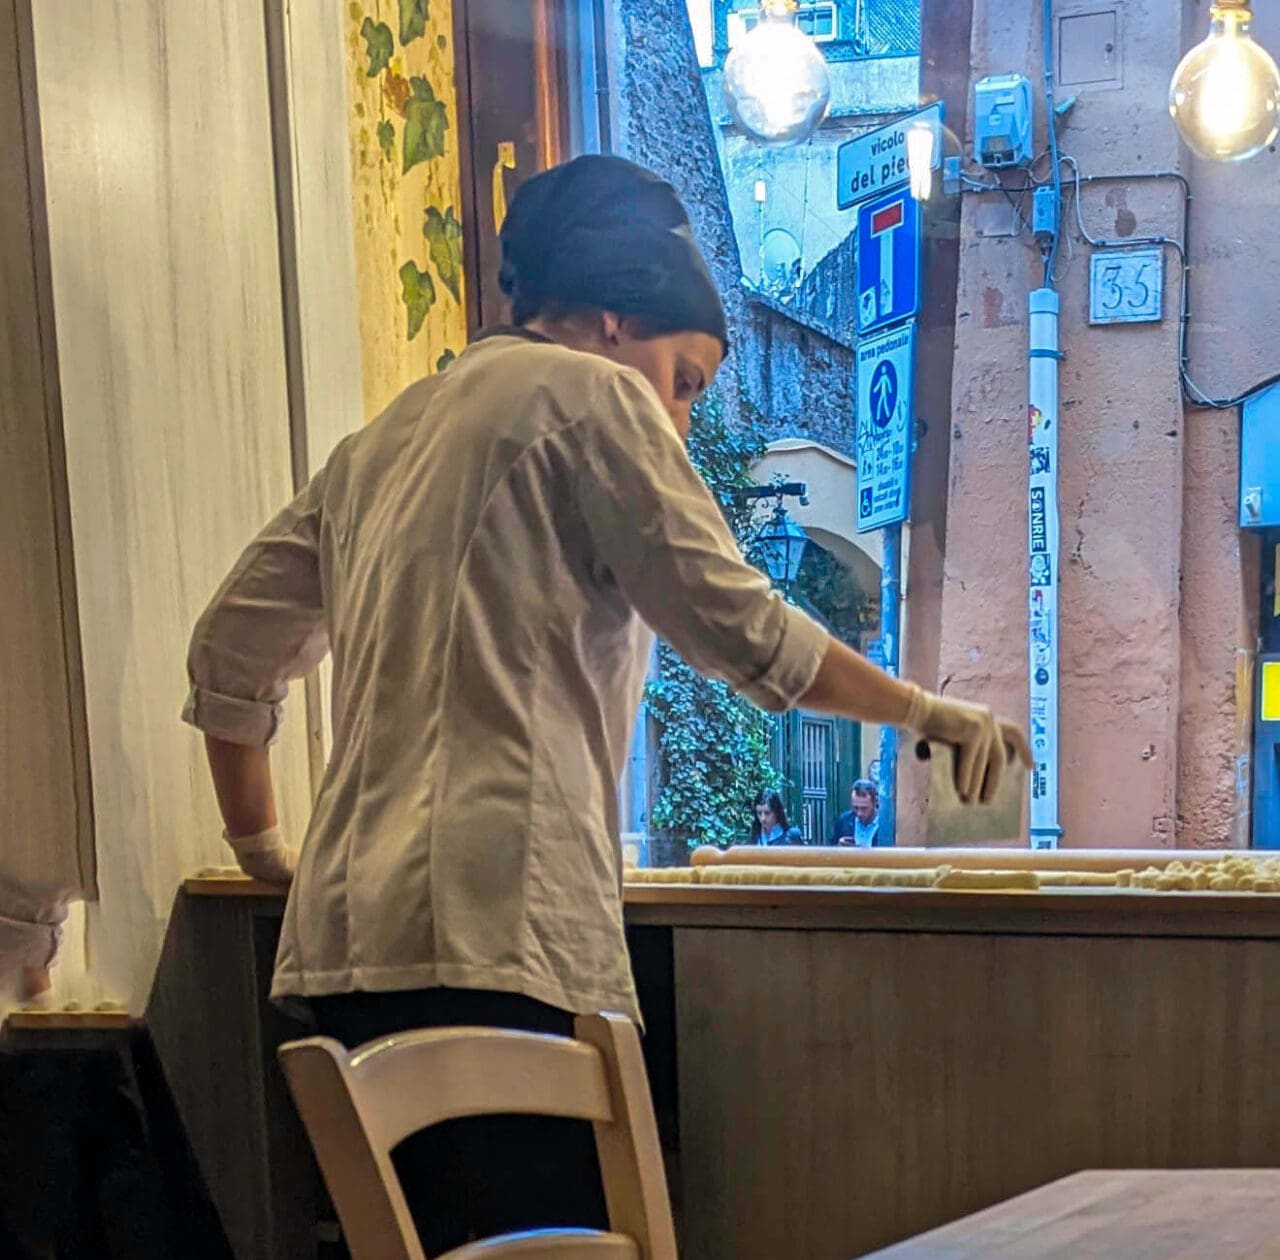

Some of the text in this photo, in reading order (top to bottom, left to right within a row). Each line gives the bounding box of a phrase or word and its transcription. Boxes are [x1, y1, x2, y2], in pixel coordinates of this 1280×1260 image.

[871, 131, 905, 156] vicolo
[851, 165, 875, 193] del
[1102, 264, 1152, 310] 35
[1031, 490, 1045, 550] SONRIE
